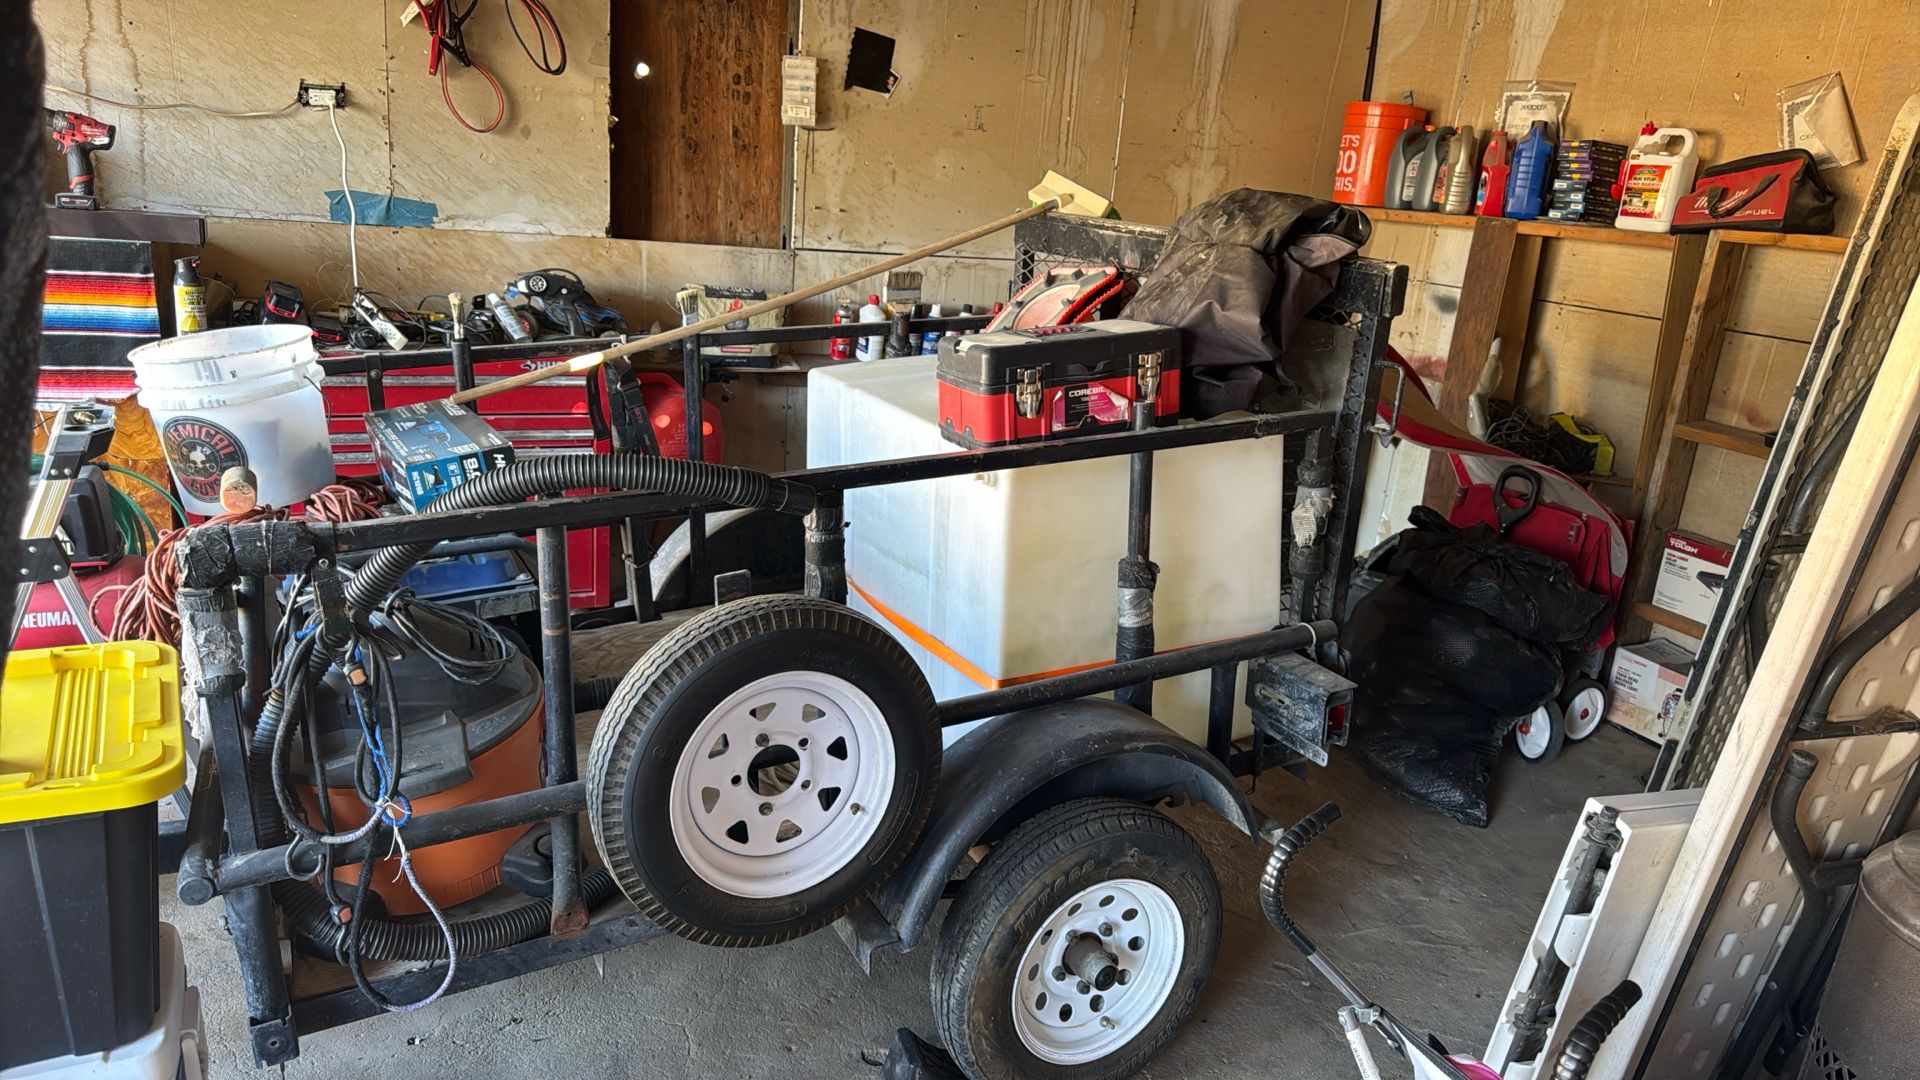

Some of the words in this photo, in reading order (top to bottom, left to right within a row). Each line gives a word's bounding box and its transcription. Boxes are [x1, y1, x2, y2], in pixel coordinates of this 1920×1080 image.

[1745, 208, 1775, 216] FUEL
[1670, 540, 1698, 554] TOUGH
[21, 611, 76, 628] NEUMA
